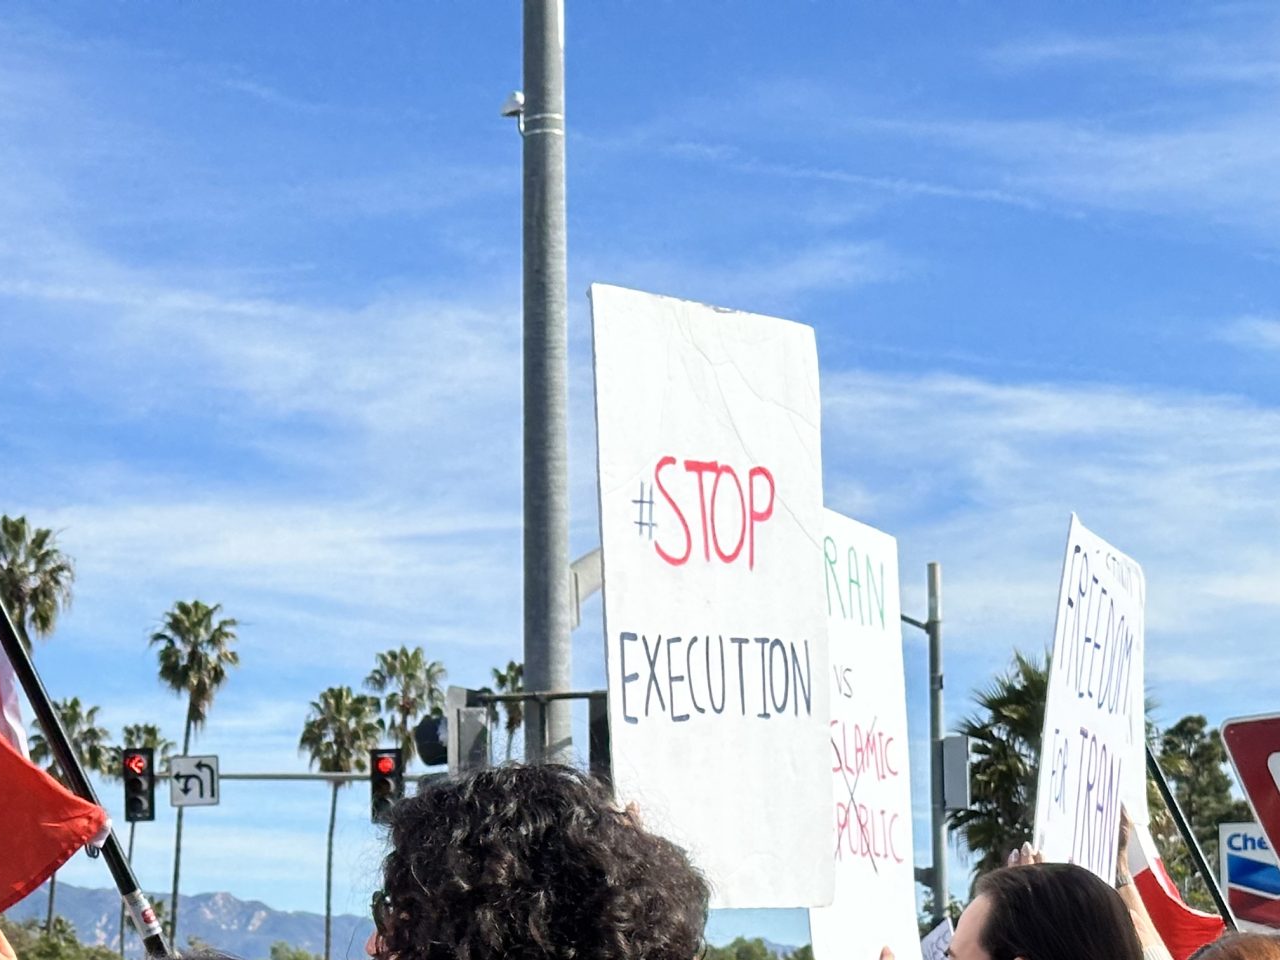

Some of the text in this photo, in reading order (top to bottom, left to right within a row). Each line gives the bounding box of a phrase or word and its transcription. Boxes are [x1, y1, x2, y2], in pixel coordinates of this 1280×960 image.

[631, 455, 776, 572] #STOP
[823, 535, 886, 631] RAN
[1058, 543, 1134, 716] FREEDOM
[620, 631, 813, 725] EXECUTION
[829, 719, 899, 782] SLAMIC
[835, 802, 904, 864] PUBLIC
[1047, 726, 1122, 886] FOR IRAN
[1226, 832, 1269, 851] Che
